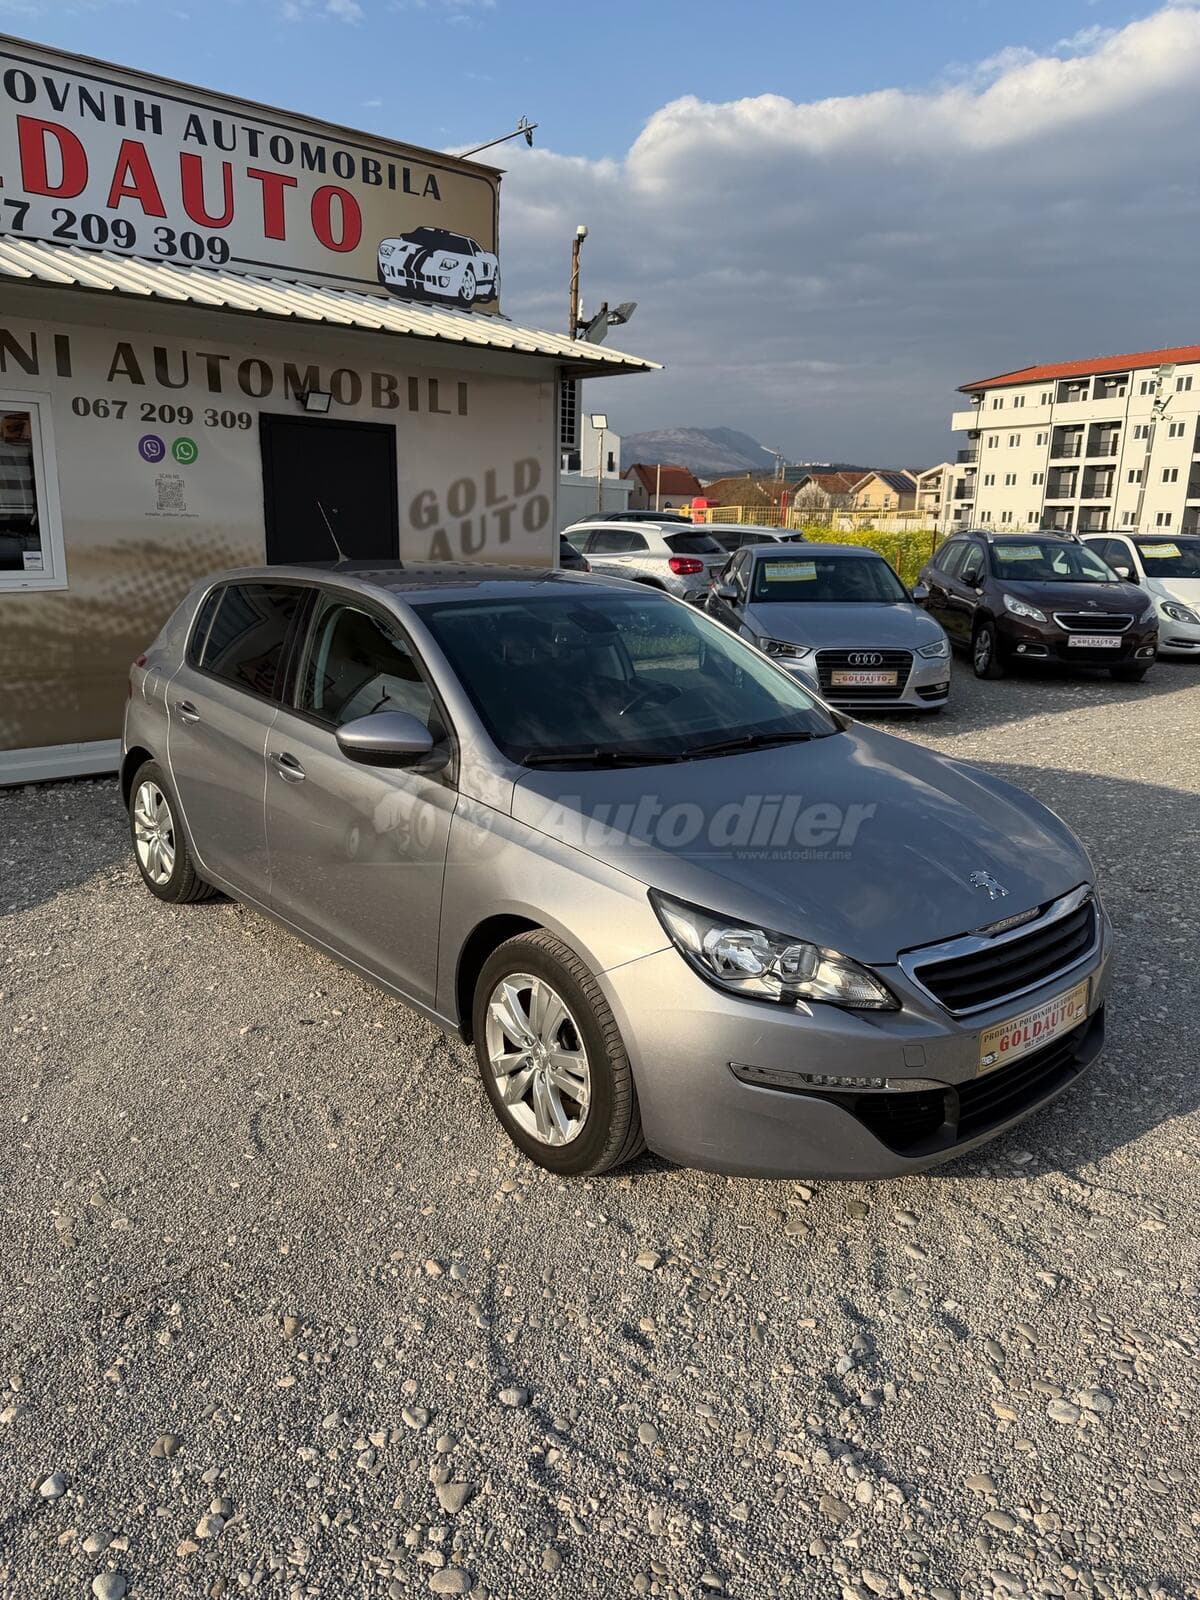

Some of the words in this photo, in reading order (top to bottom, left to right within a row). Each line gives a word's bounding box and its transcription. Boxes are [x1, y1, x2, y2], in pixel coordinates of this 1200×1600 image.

[3, 68, 163, 135] OVNIH
[183, 112, 441, 201] AUTOMOBILA
[0, 114, 362, 253] DAUTO
[0, 198, 30, 231] 7
[52, 207, 137, 249] 209
[154, 226, 231, 265] 309
[0, 328, 72, 377] NI
[107, 342, 468, 416] AUTOMOBILI
[72, 397, 128, 420] 067
[140, 403, 193, 425] 209
[204, 408, 252, 430] 309
[409, 457, 541, 531] GOLD
[428, 494, 549, 561] AUTO
[984, 1023, 1017, 1043] PRODAJA
[1019, 1007, 1052, 1027] POLOVNIH
[999, 1001, 1074, 1052] GOLDAUTO
